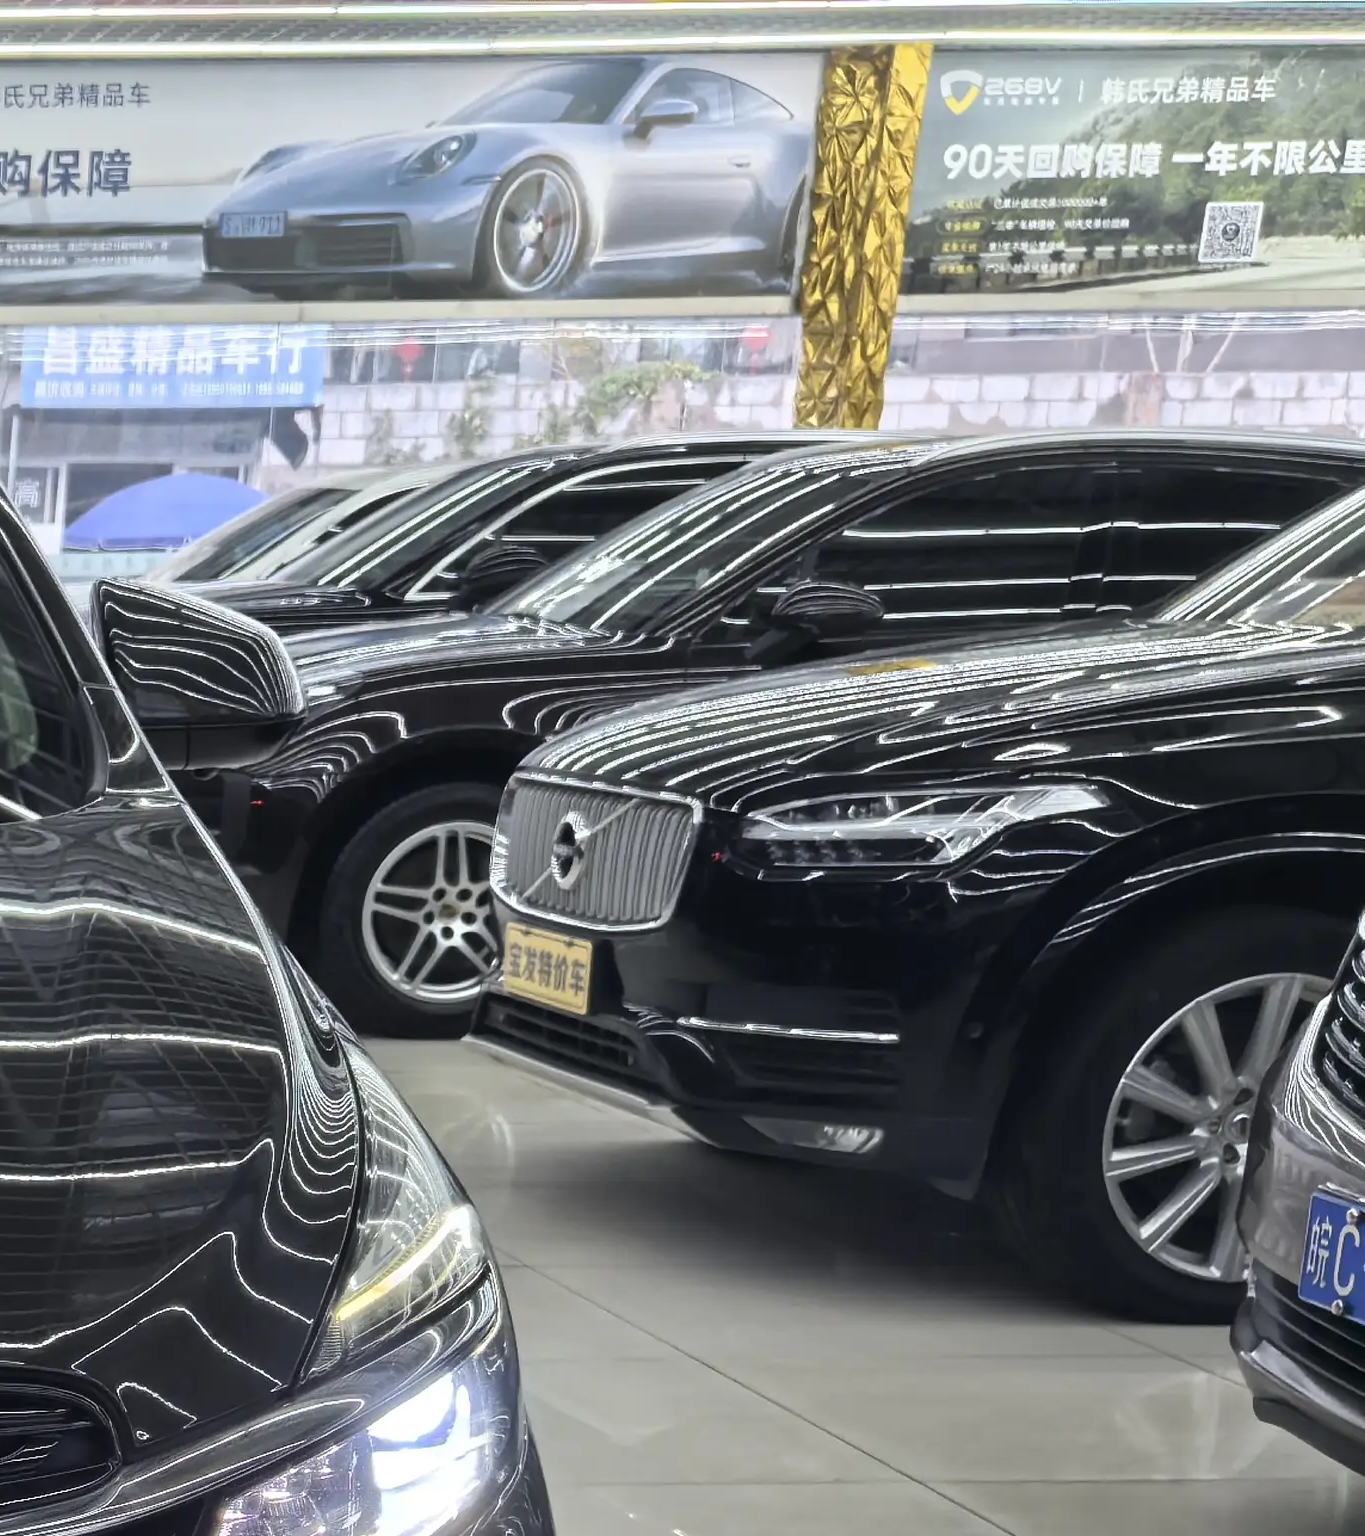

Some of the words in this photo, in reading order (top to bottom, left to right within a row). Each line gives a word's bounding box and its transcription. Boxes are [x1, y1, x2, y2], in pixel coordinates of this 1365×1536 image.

[984, 77, 1063, 96] 268V
[1101, 75, 1276, 104] 韩氏兄弟精品车
[943, 142, 1162, 180] 90天回购保障
[1171, 138, 1365, 177] 一年不限公里
[508, 942, 586, 997] 宝发特价车
